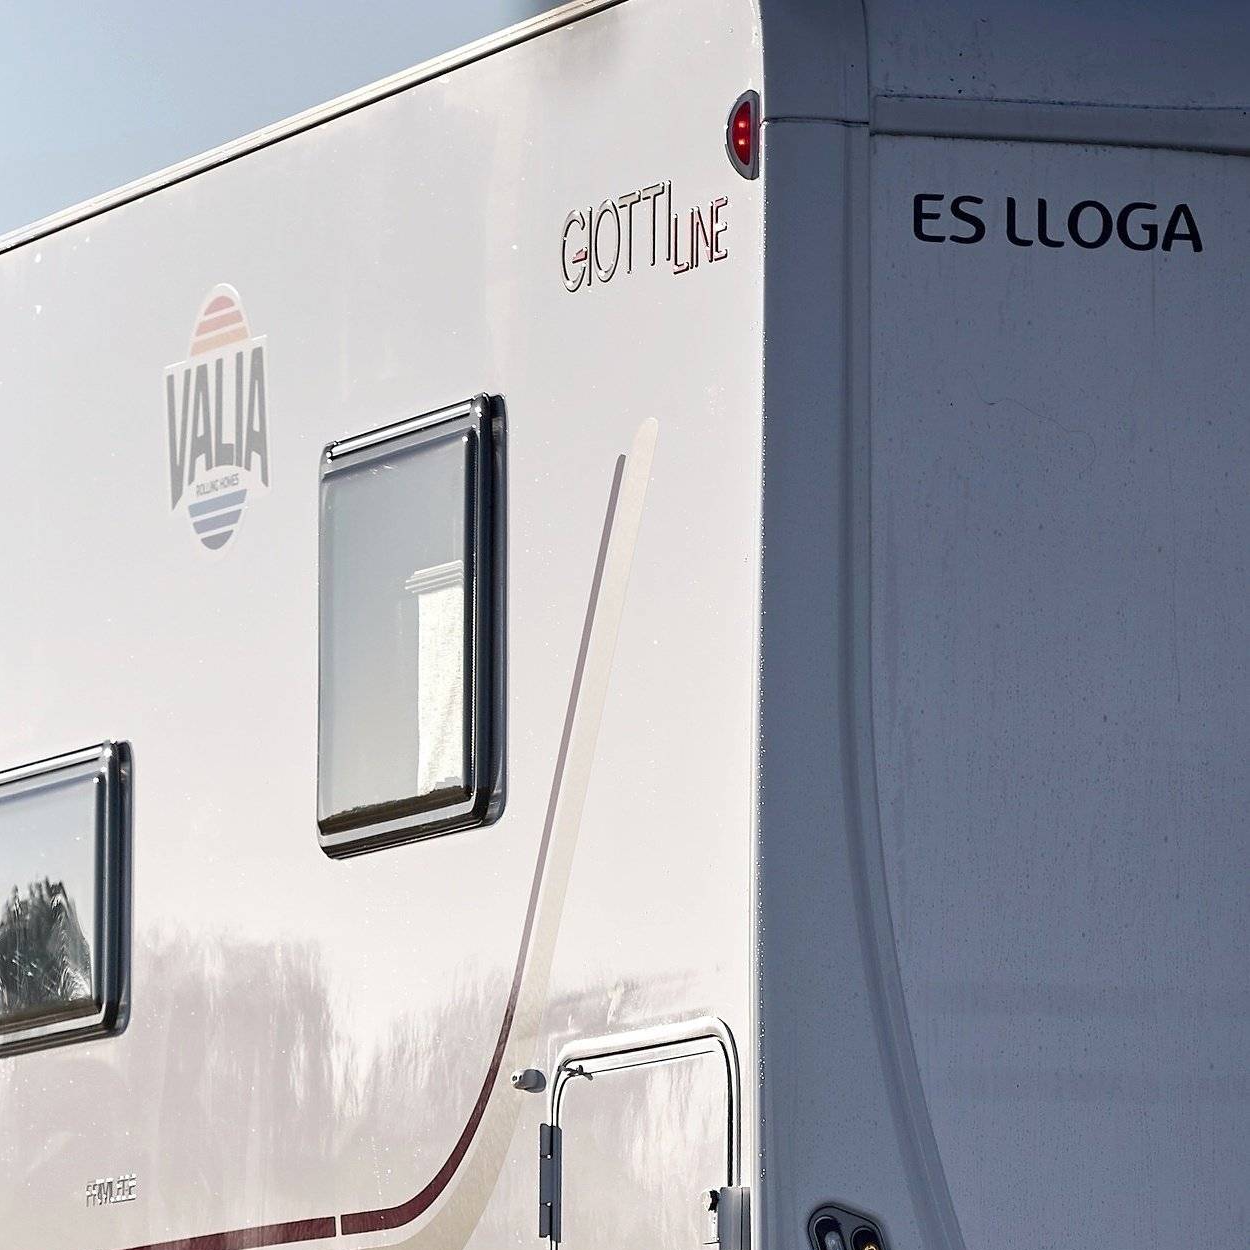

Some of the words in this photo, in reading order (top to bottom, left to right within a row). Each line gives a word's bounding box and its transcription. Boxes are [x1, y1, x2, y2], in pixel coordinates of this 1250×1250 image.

[913, 193, 986, 244] ES
[1006, 196, 1203, 253] LLOGA
[166, 346, 269, 511] VALIA
